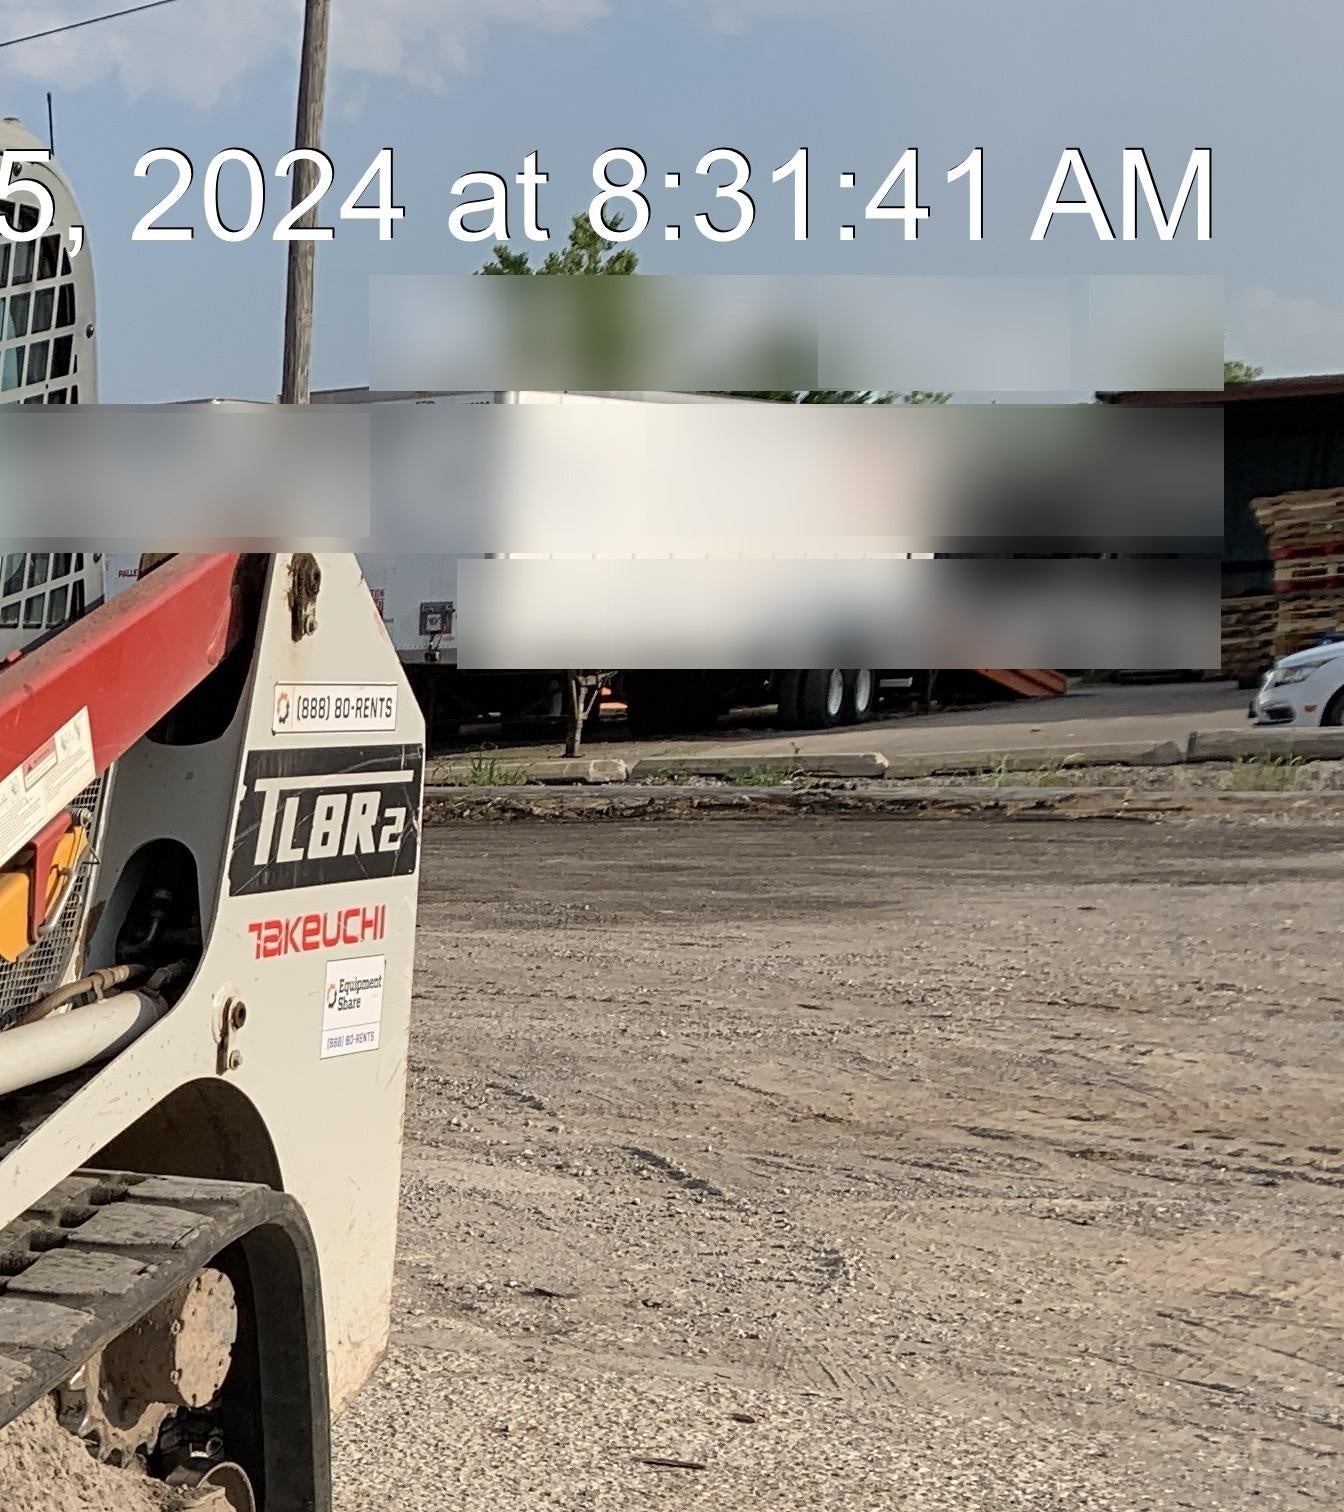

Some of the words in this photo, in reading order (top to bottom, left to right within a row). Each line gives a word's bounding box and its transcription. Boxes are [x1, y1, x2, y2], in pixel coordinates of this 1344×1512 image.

[297, 695, 331, 721] (888)
[334, 696, 393, 719] 80-RENTS
[248, 905, 387, 960] TAKEUCHI
[339, 976, 383, 995] Equipment
[338, 996, 361, 1011] Share
